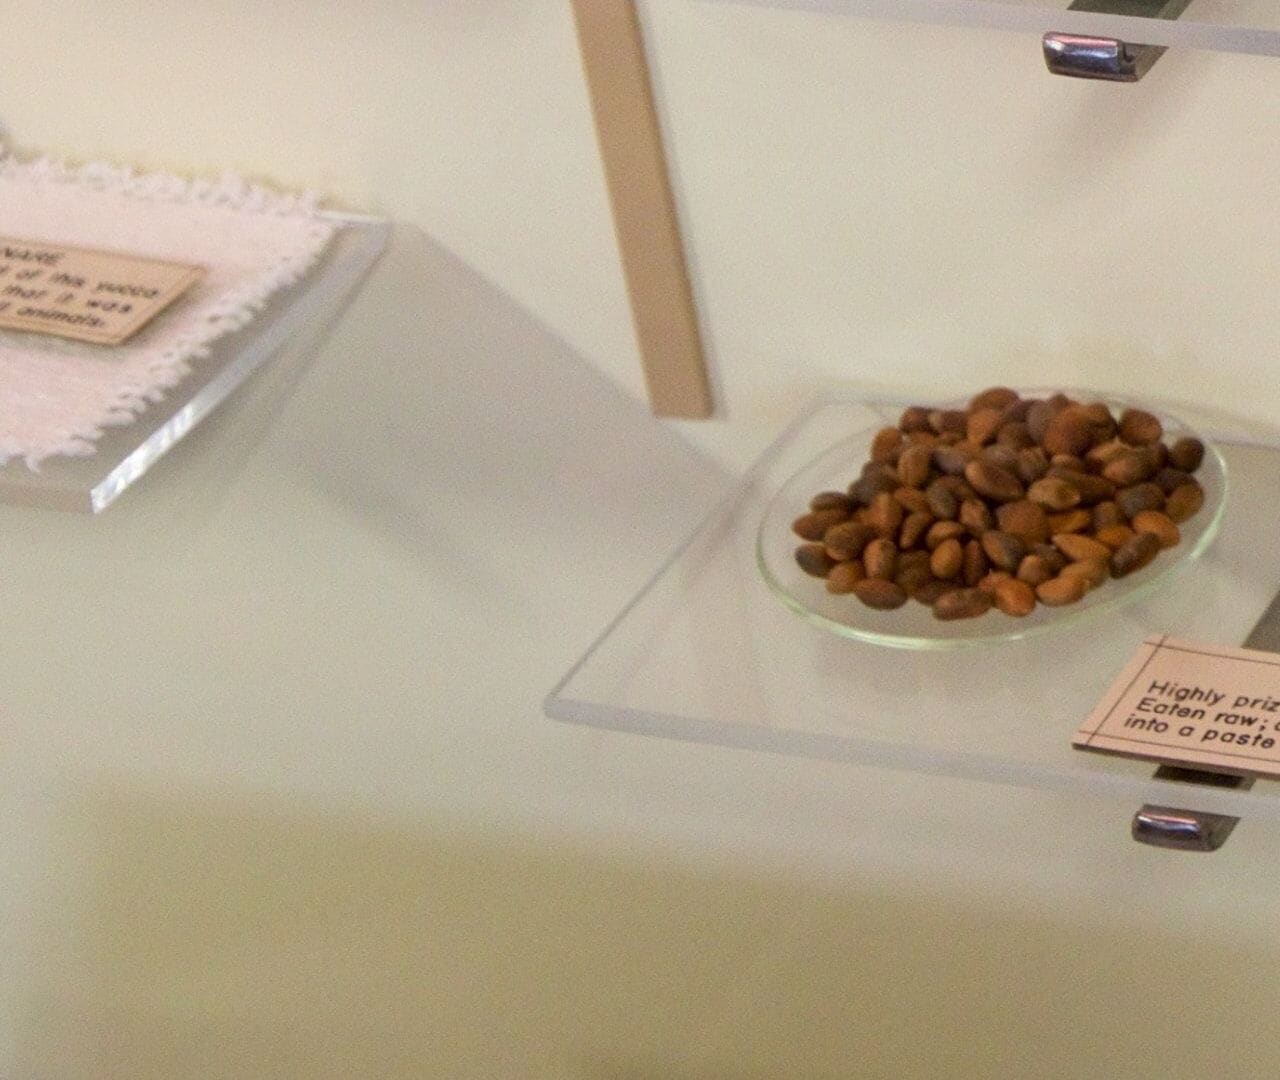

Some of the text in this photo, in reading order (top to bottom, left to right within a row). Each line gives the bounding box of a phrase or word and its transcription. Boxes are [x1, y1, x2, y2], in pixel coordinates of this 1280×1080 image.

[1147, 680, 1226, 707] Highly
[1136, 697, 1206, 720] Eaten
[1214, 712, 1266, 732] raw;
